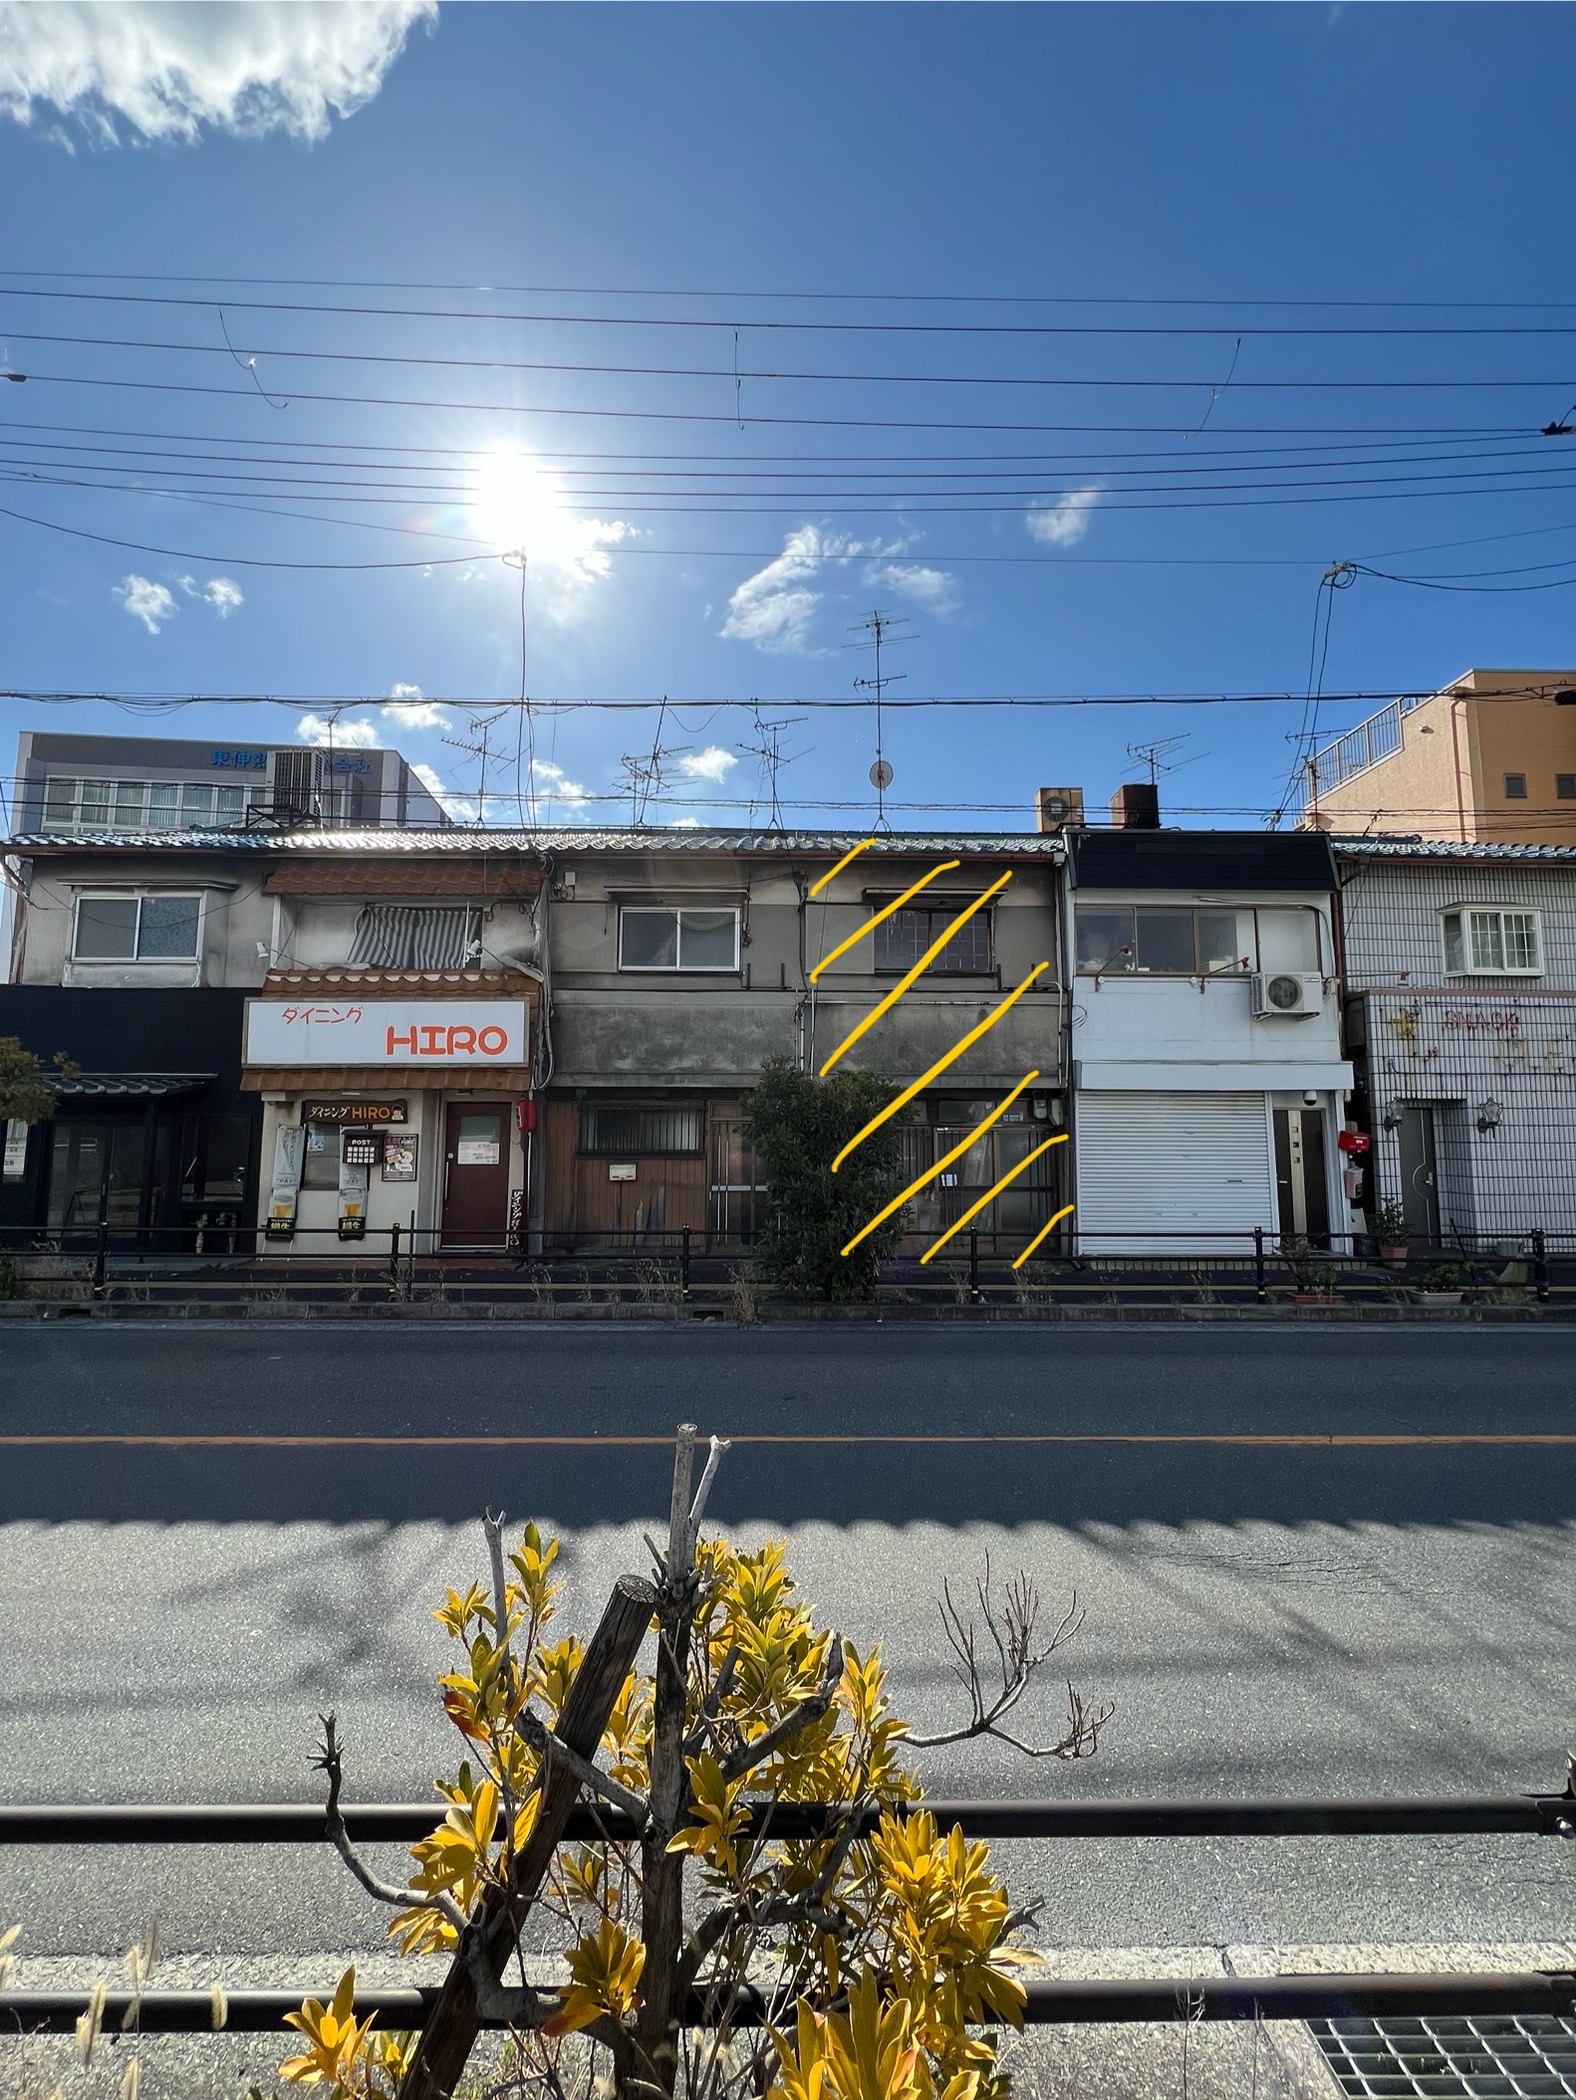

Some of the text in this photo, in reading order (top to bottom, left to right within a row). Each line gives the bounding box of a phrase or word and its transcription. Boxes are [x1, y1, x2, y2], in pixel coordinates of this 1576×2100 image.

[281, 1006, 364, 1025] ダイニング
[1445, 1010, 1517, 1031] SNACK
[385, 1025, 508, 1056] HIRO
[308, 1106, 391, 1119] ダイニング HIRO
